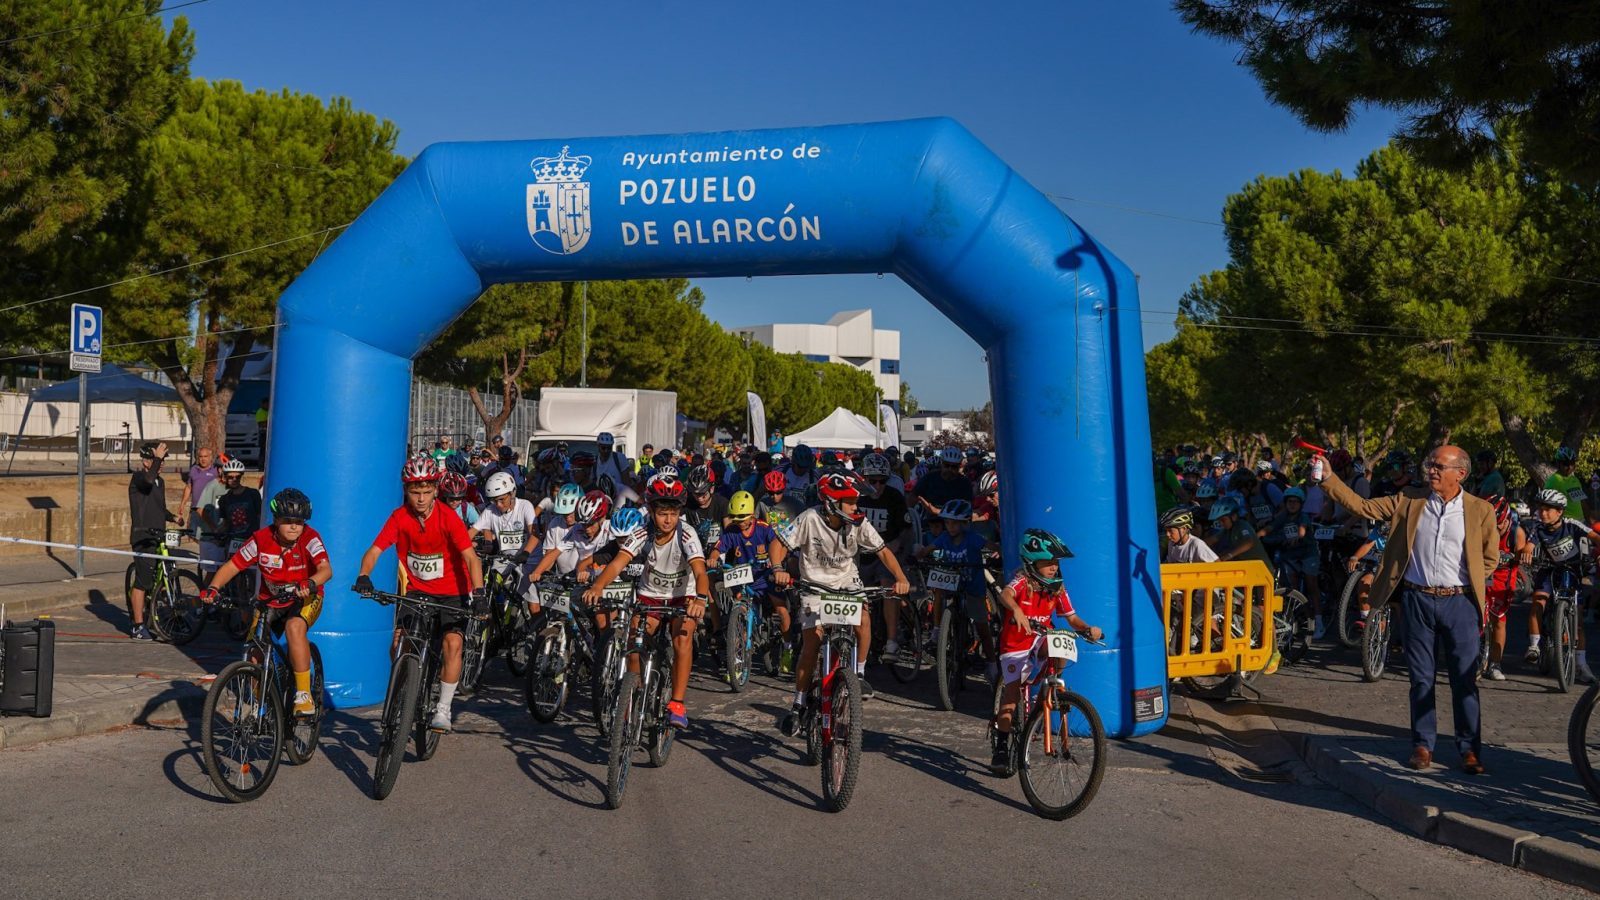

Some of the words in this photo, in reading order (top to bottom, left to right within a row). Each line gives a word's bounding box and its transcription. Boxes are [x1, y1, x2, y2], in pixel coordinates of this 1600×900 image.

[622, 145, 783, 170] Ayuntamiento
[792, 143, 821, 159] de
[620, 175, 756, 205] POZUELO
[621, 221, 659, 246] DE
[674, 202, 820, 245] ALARCÓN
[79, 311, 96, 348] P
[734, 545, 742, 558] 6
[412, 560, 437, 572] 0761
[726, 568, 748, 581] 0577
[930, 572, 957, 584] 0603
[543, 593, 566, 606] 0615
[824, 603, 858, 616] 0569
